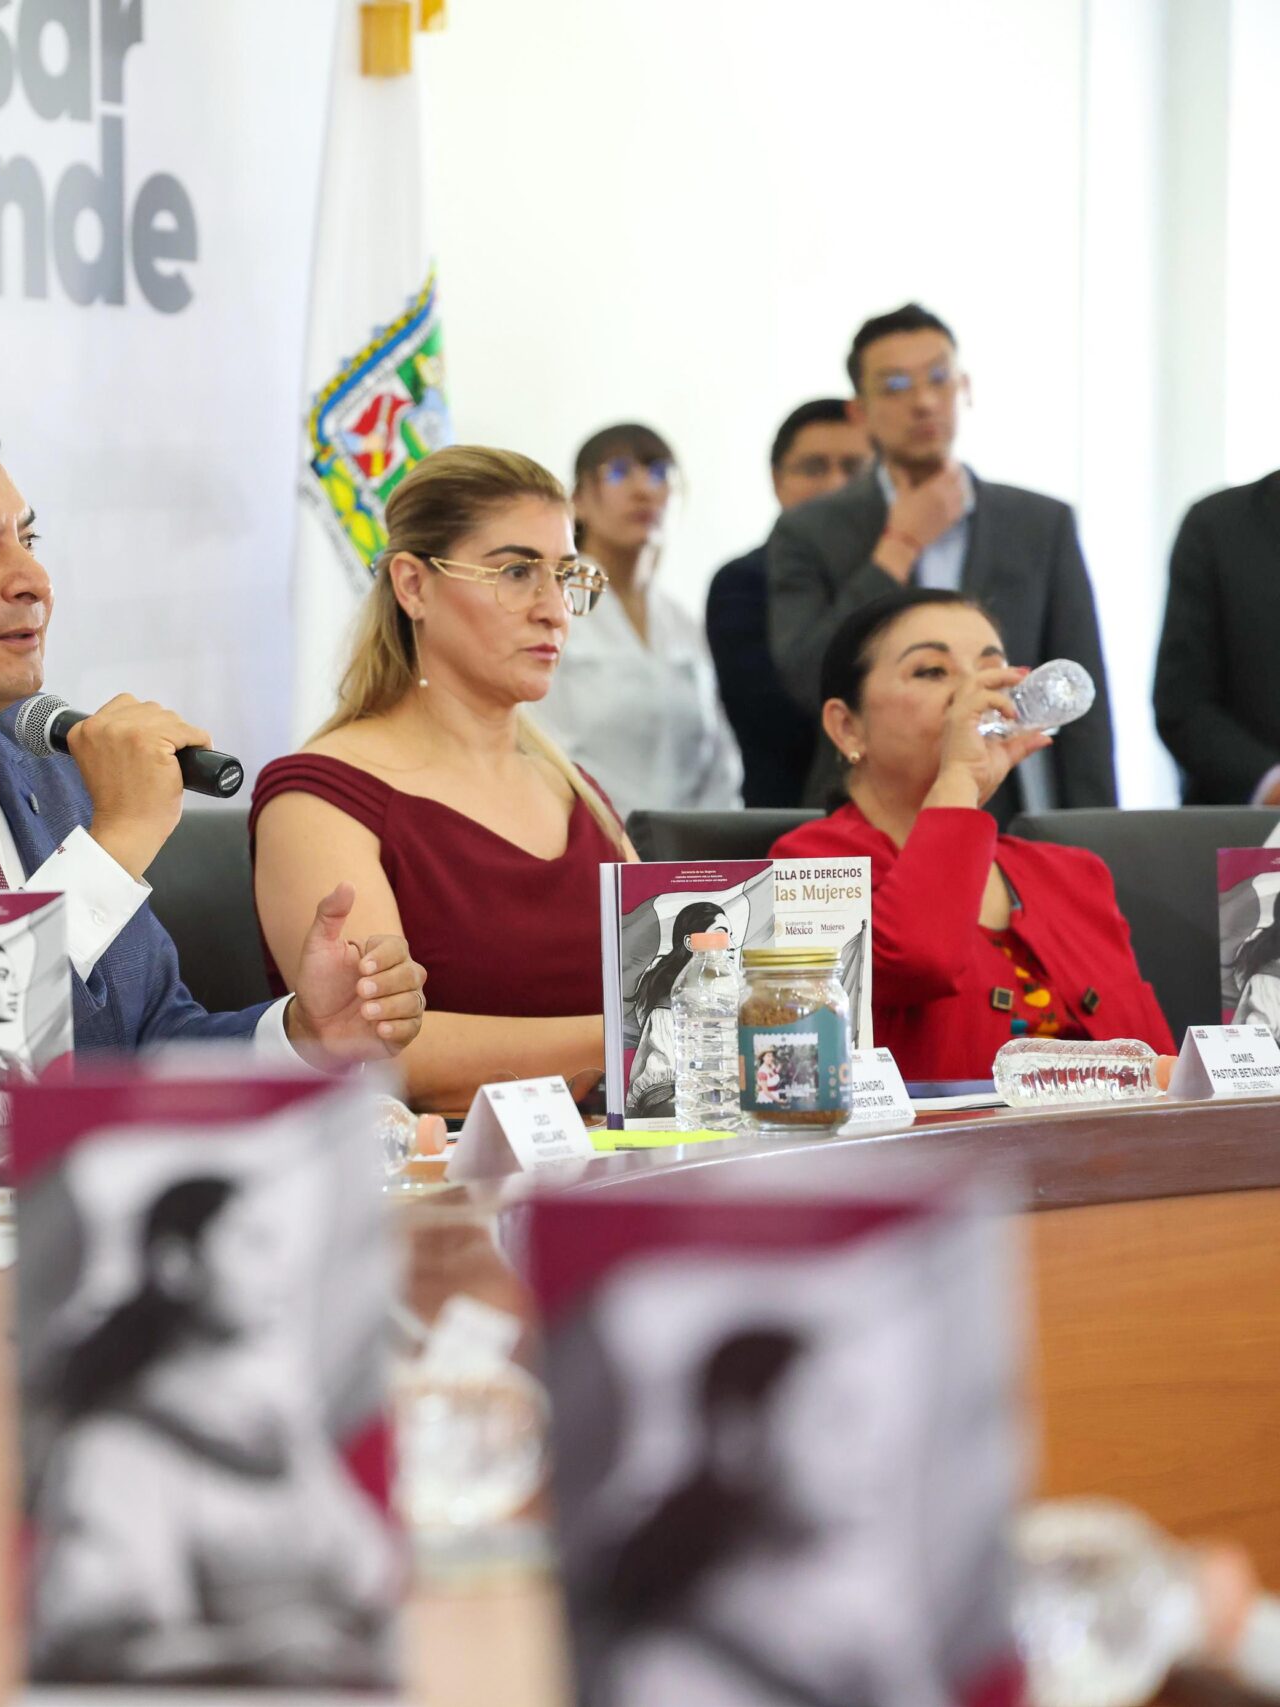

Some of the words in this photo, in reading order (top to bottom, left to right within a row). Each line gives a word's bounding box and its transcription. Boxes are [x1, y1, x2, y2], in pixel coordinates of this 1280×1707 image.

[775, 870, 797, 880] ILLA
[800, 869, 811, 879] DE
[814, 868, 862, 879] DERECHOS
[775, 885, 797, 901] las
[802, 884, 862, 904] Mujeres
[785, 926, 813, 935] México
[820, 923, 845, 931] Mujeres
[1230, 1053, 1255, 1063] IDAMIS
[1211, 1068, 1238, 1079] PASTOR
[852, 1080, 884, 1092] EJANDRO
[852, 1097, 878, 1108] MENTA
[879, 1096, 895, 1106] MIER
